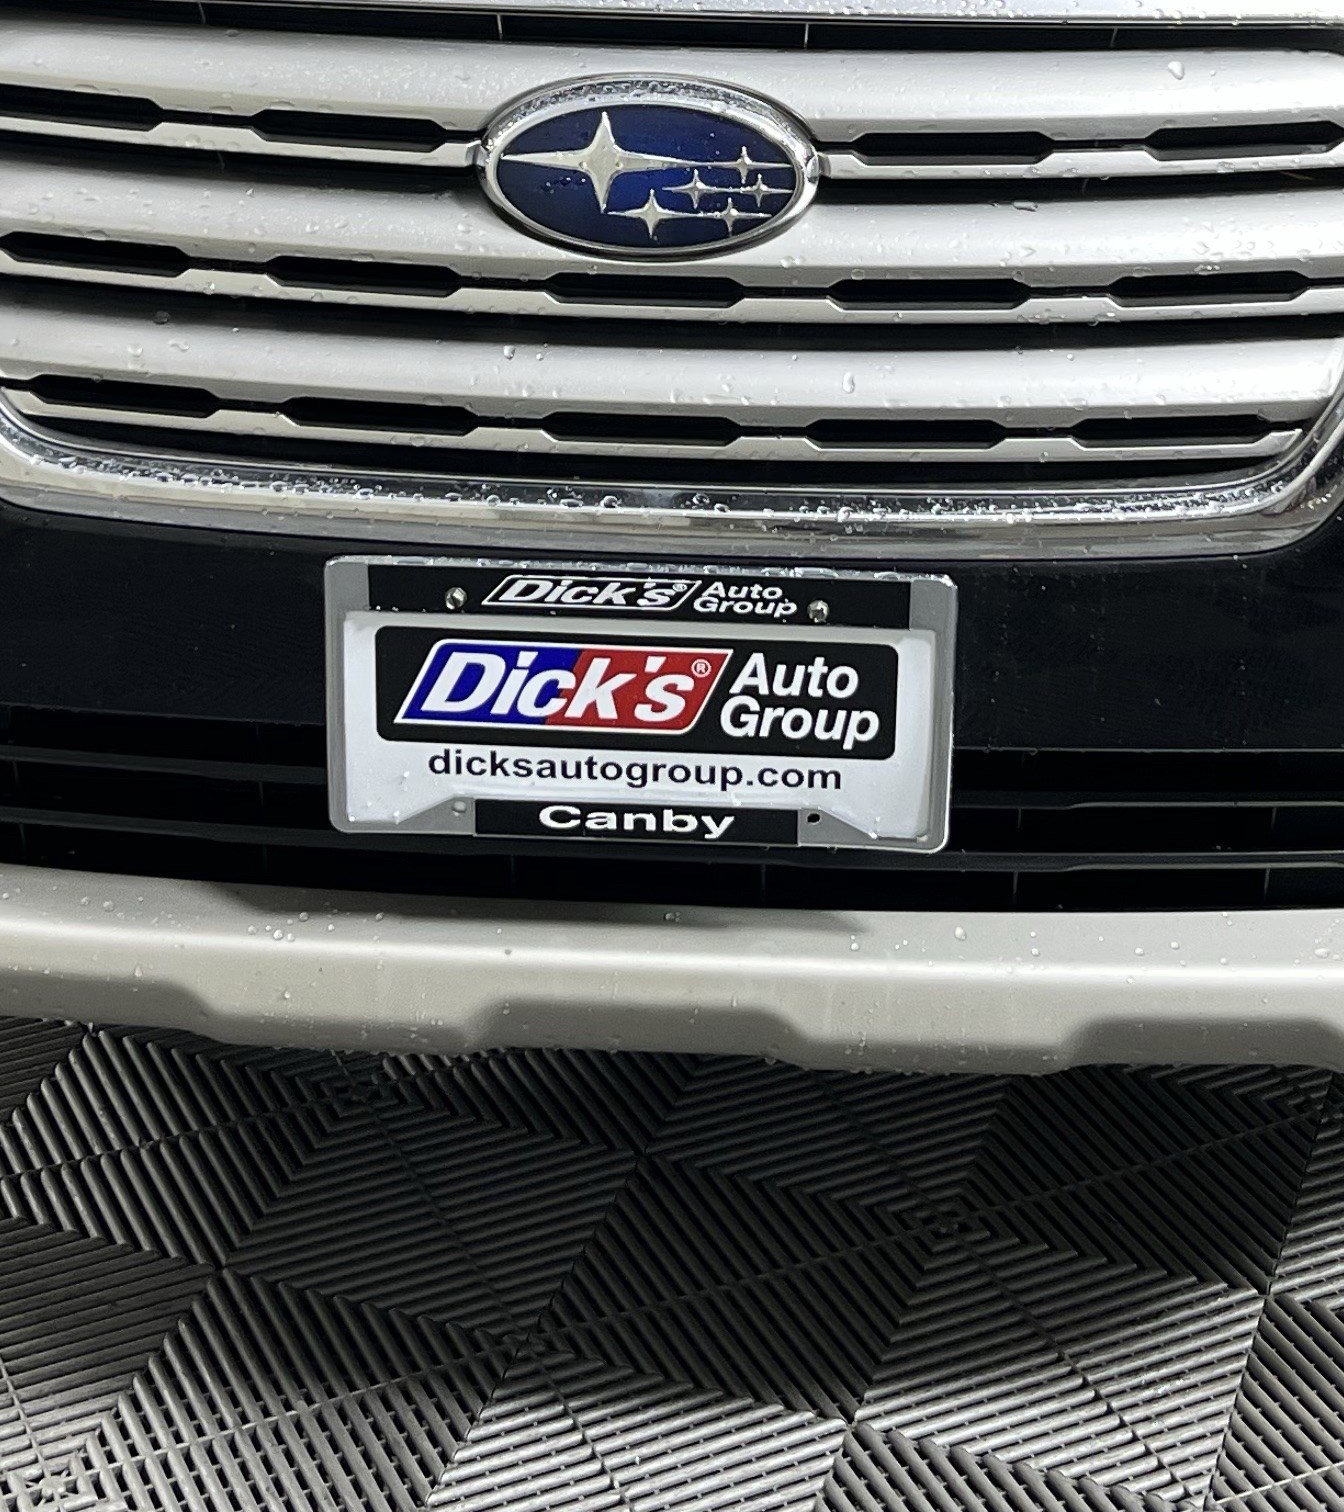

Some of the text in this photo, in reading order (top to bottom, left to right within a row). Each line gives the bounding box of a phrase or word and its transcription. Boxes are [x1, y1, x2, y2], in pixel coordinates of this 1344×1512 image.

[498, 579, 675, 607] Dick's
[693, 597, 798, 617] Group
[701, 581, 783, 600] Auto
[420, 650, 696, 723] Dick's
[729, 652, 859, 699] Auto
[719, 697, 880, 751] Group
[427, 748, 843, 791] dicksautogroup.com
[538, 804, 736, 839] Canby
